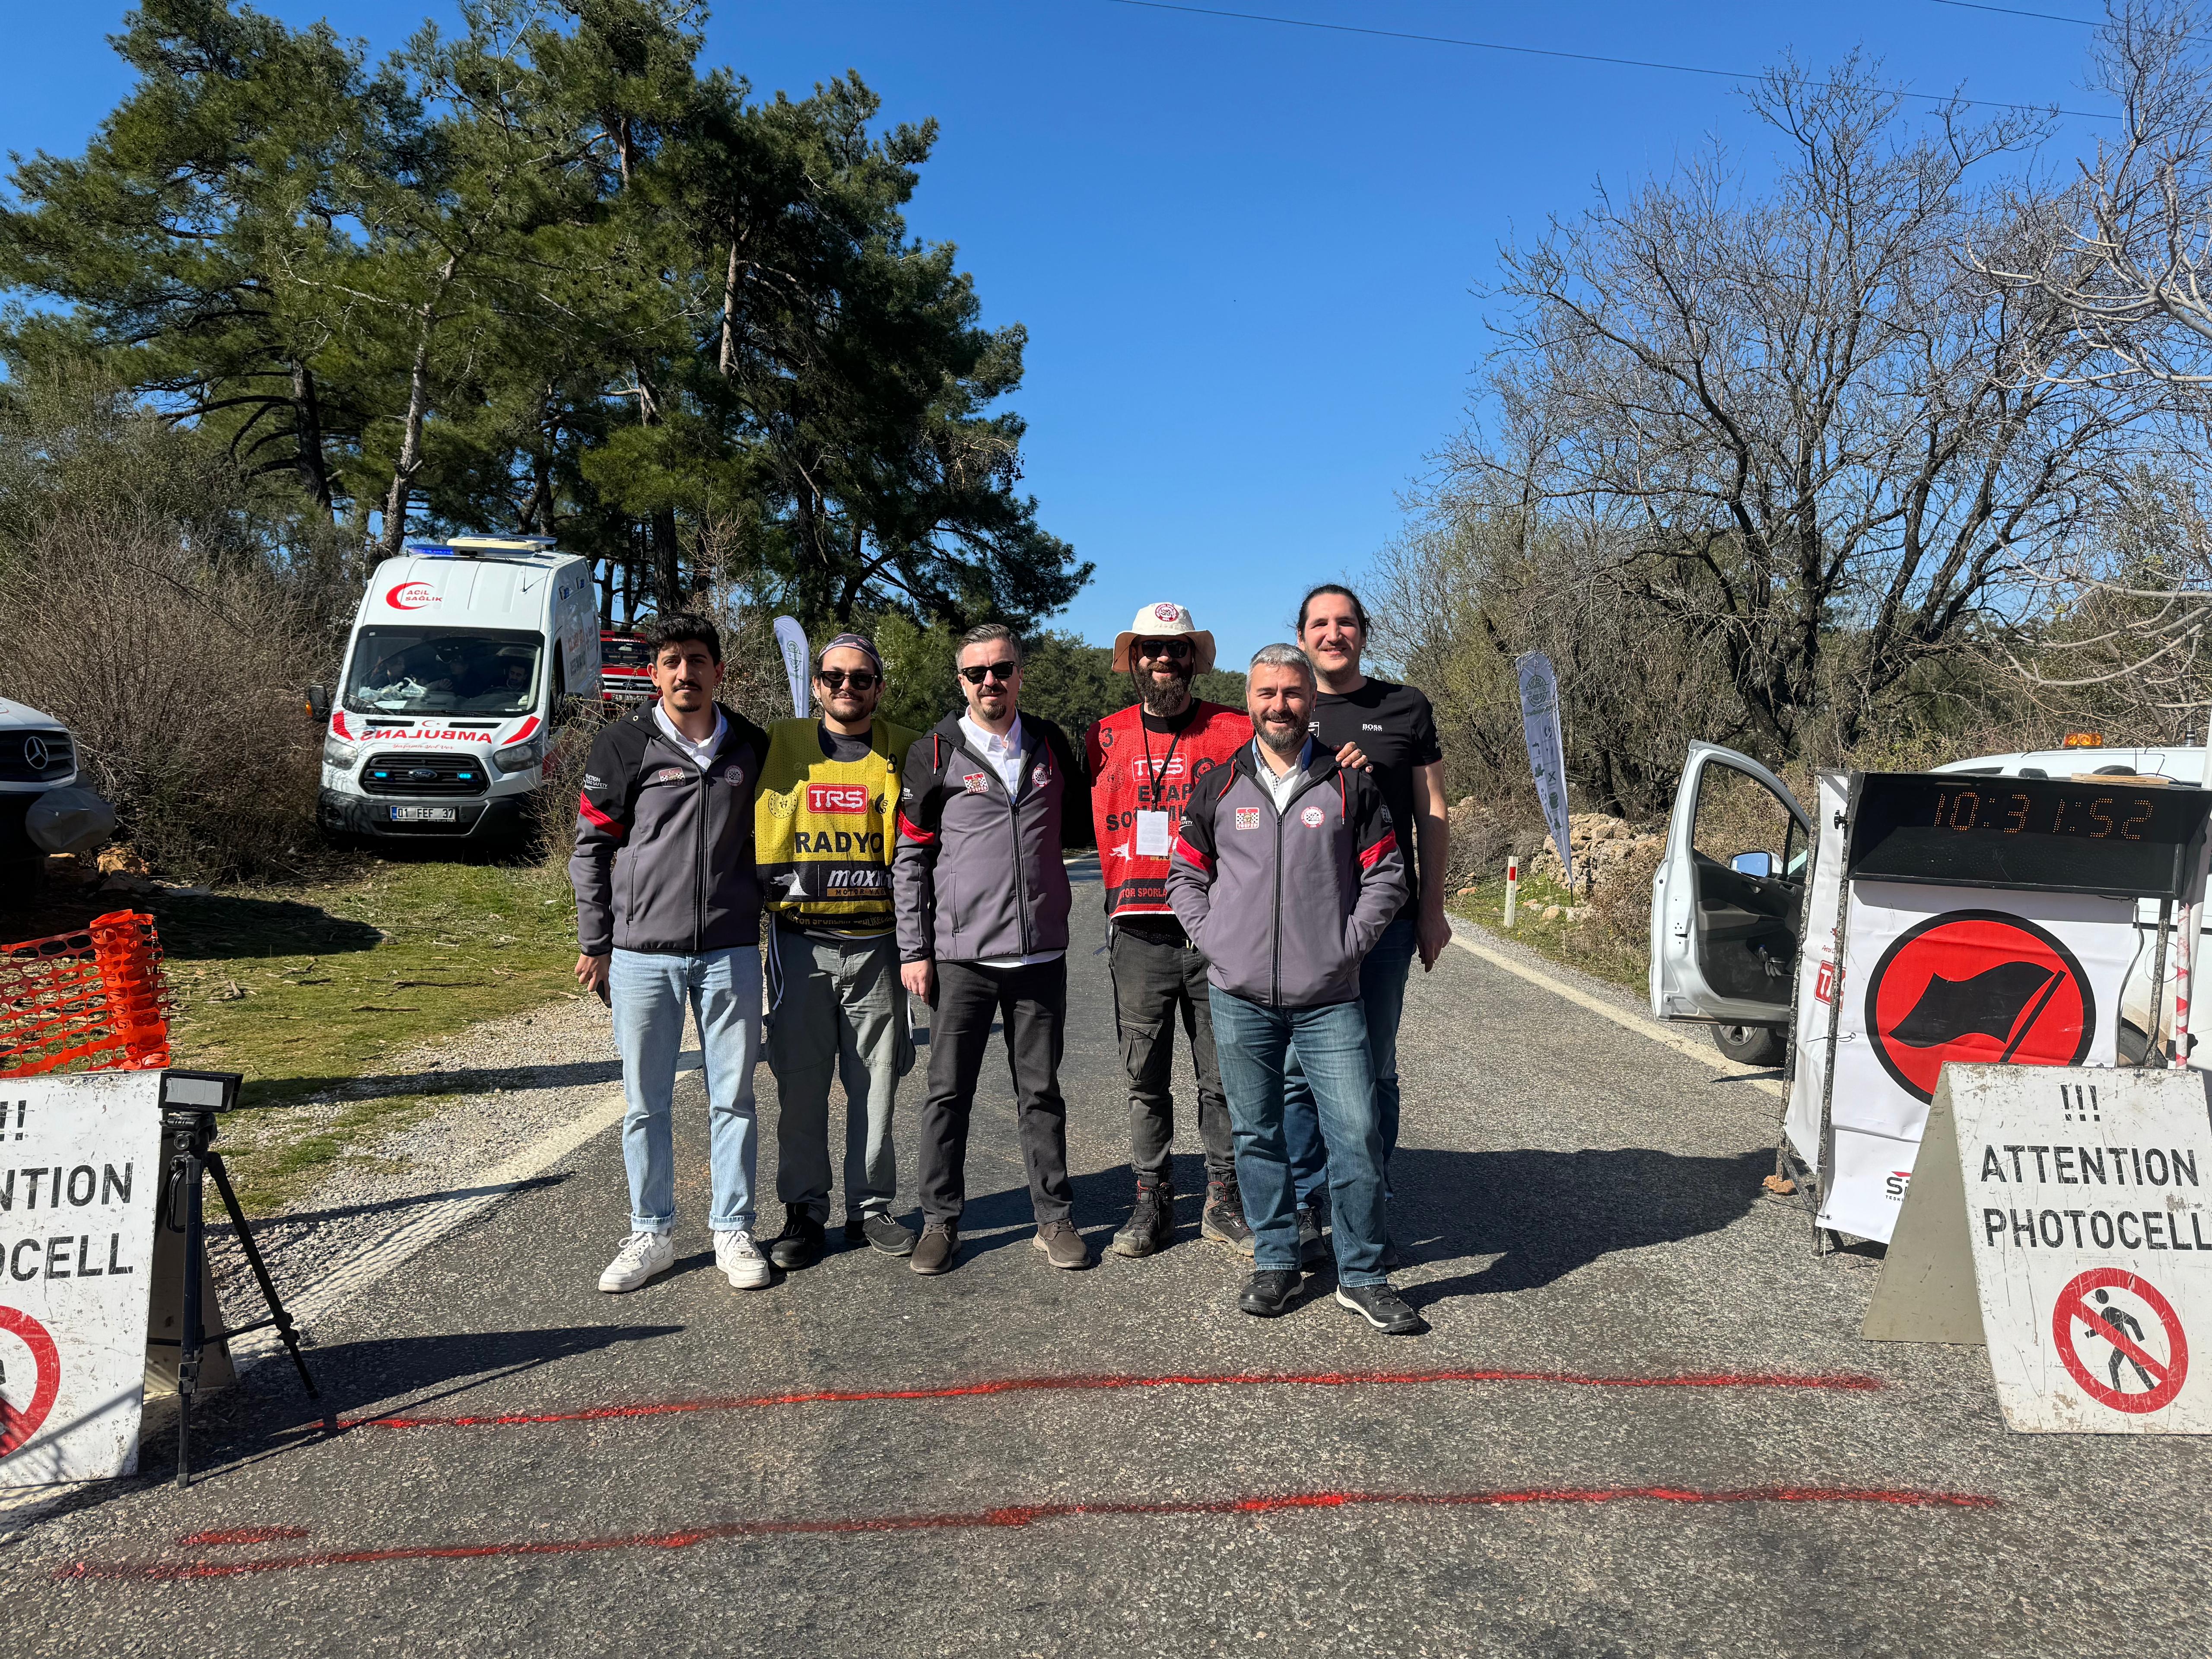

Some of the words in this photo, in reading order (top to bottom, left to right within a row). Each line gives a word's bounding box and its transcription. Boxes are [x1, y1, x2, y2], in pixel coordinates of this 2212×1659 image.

[1101, 727, 1113, 747] 3
[887, 753, 897, 774] 8
[1134, 757, 1184, 776] TRS
[810, 790, 864, 808] TRS
[1138, 784, 1192, 802] ETAP
[398, 808, 408, 817] 01
[417, 808, 434, 818] FEF
[442, 809, 454, 818] 37
[795, 831, 884, 853] RADYO
[1980, 1144, 2199, 1187] ATTENTION
[1983, 1208, 2212, 1251] PHOTOCELL
